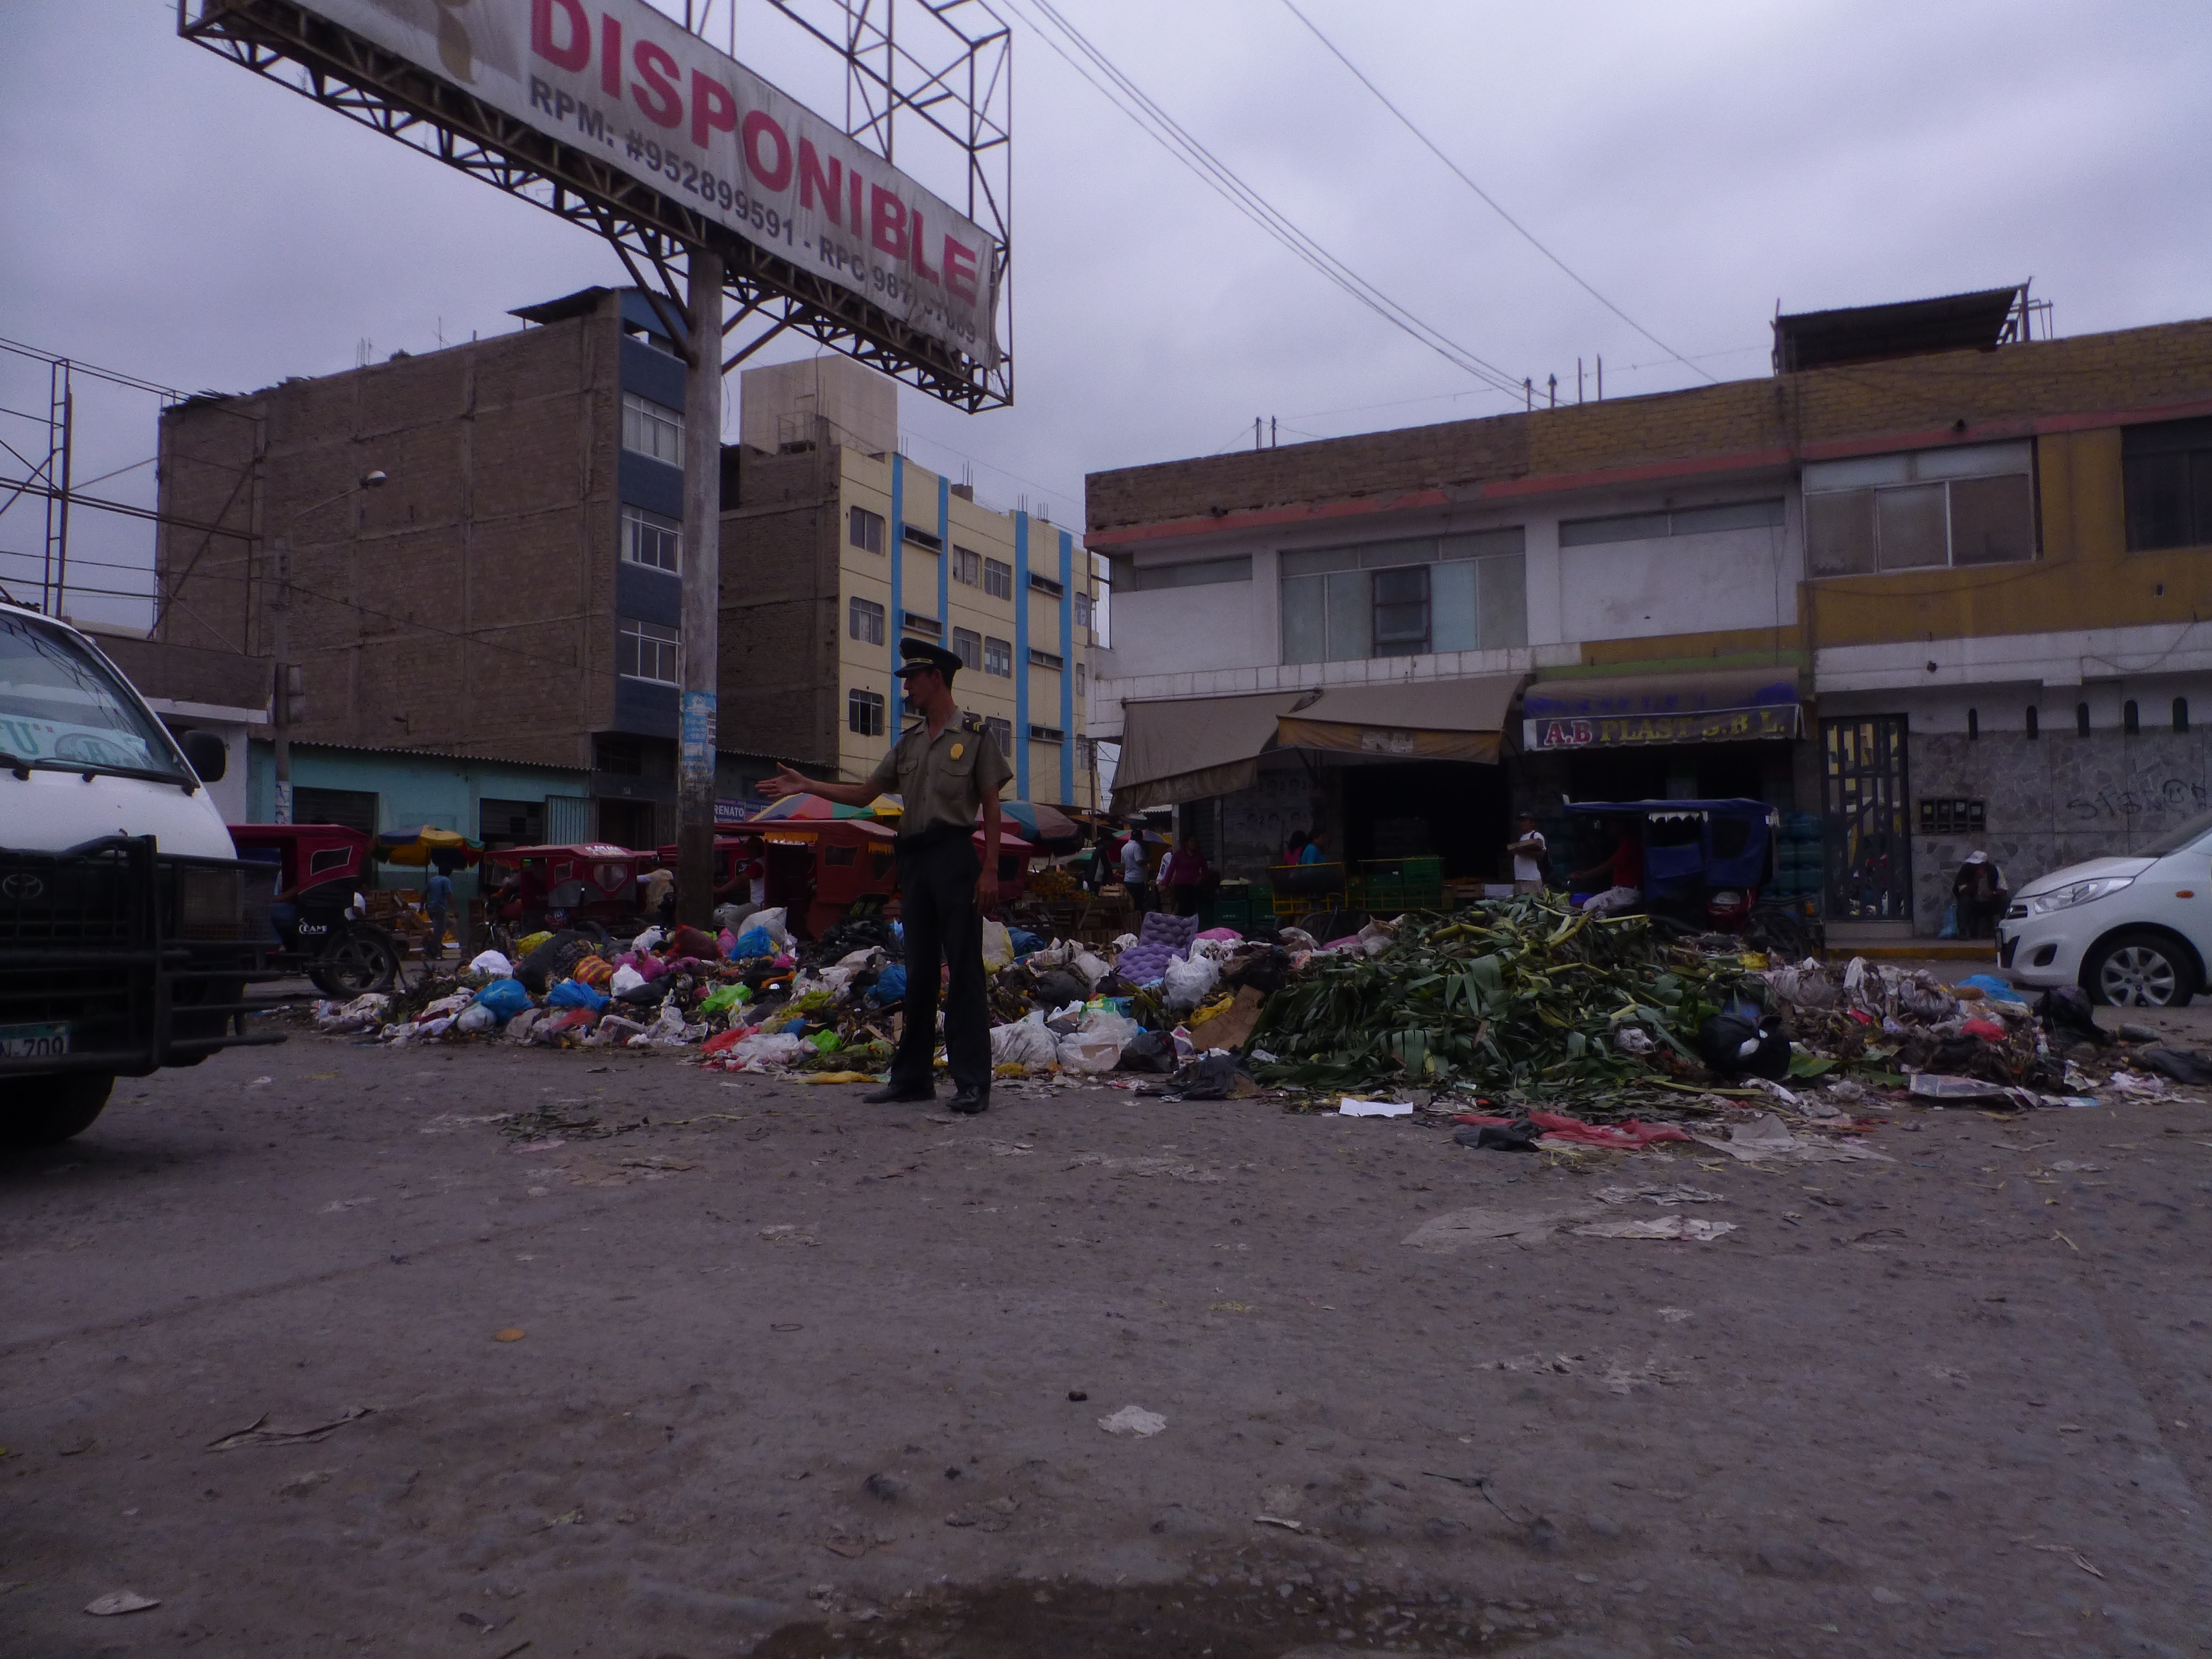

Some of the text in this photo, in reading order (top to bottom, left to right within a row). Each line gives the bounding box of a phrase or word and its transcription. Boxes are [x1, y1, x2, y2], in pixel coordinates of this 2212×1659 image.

[529, 74, 614, 148] RPM:
[626, 129, 793, 246] #952899591
[530, 0, 977, 309] DISPONIBLE
